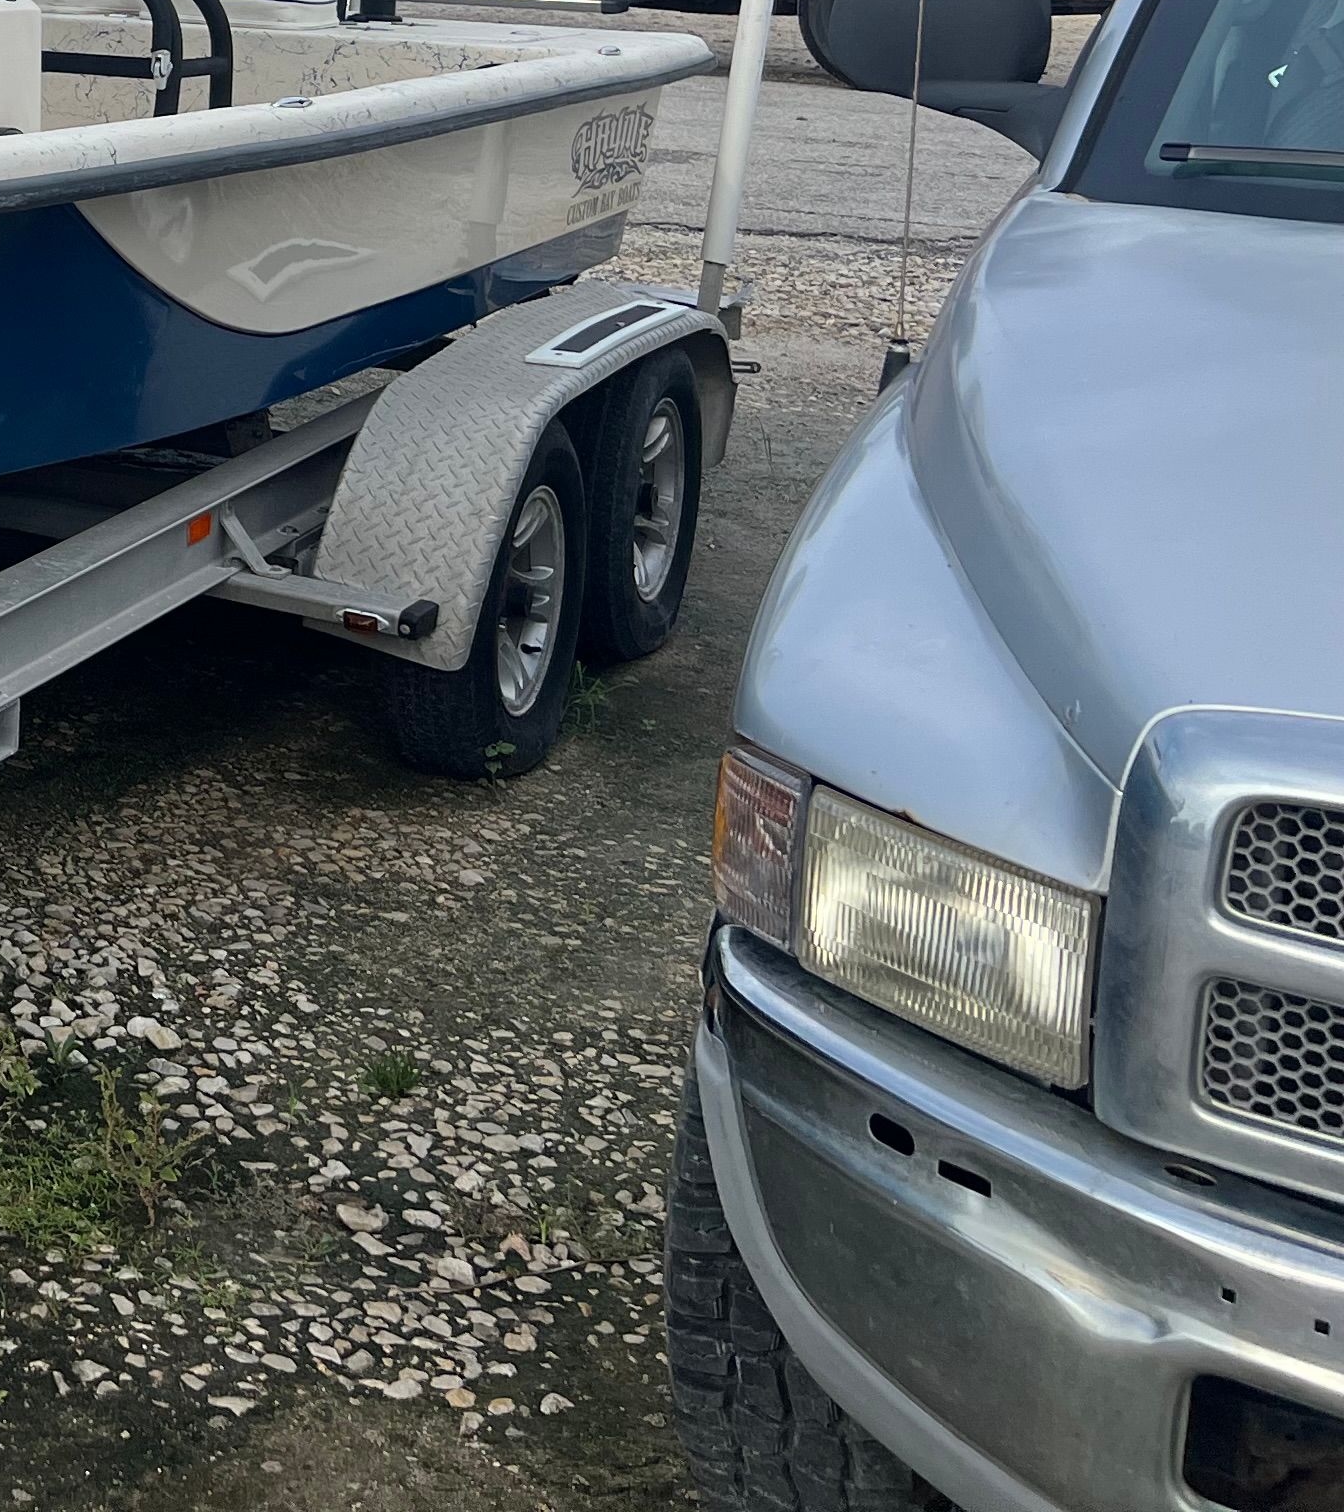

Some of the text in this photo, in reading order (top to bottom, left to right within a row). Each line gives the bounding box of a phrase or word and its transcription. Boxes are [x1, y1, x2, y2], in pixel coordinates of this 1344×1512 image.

[566, 182, 642, 227] CUSTOM BAY BOATS
